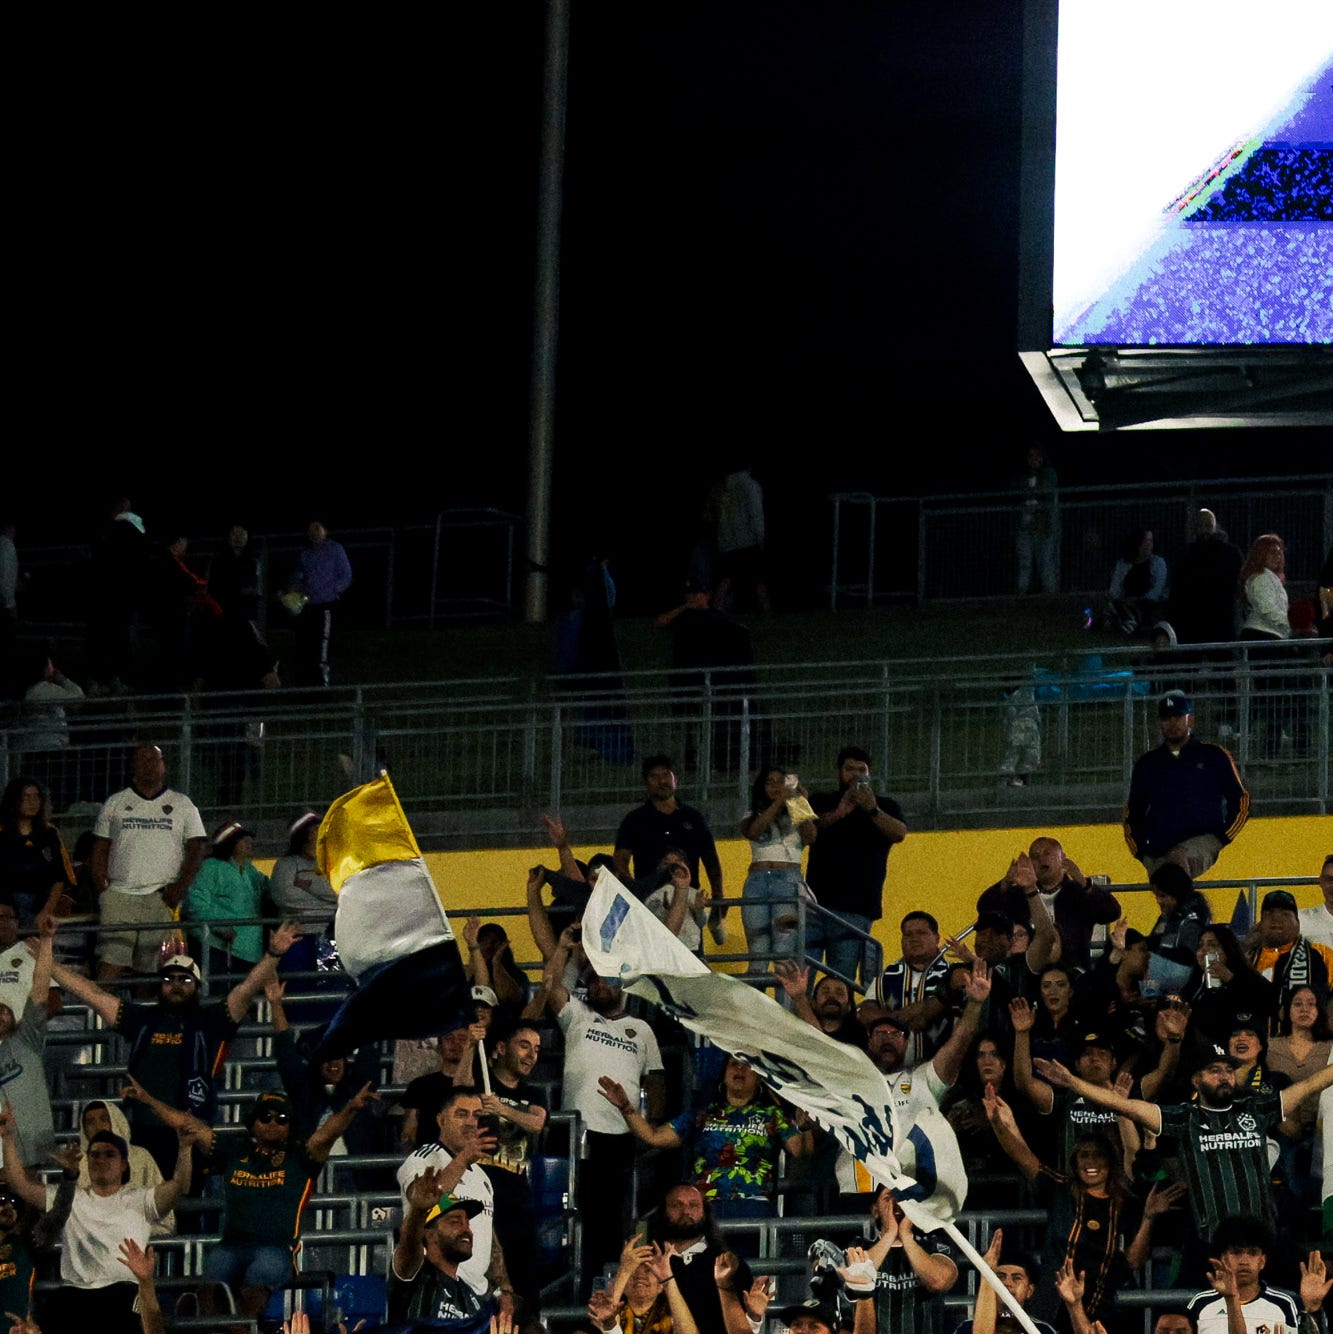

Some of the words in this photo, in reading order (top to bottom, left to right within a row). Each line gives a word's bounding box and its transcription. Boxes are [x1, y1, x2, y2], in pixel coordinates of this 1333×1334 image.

[585, 1034, 639, 1055] NUTRITION
[1069, 1110, 1118, 1121] HERBALI
[1199, 1131, 1262, 1144] HERBALIFE
[1200, 1139, 1263, 1152] NUTRITION
[876, 1271, 919, 1283] ERBALI
